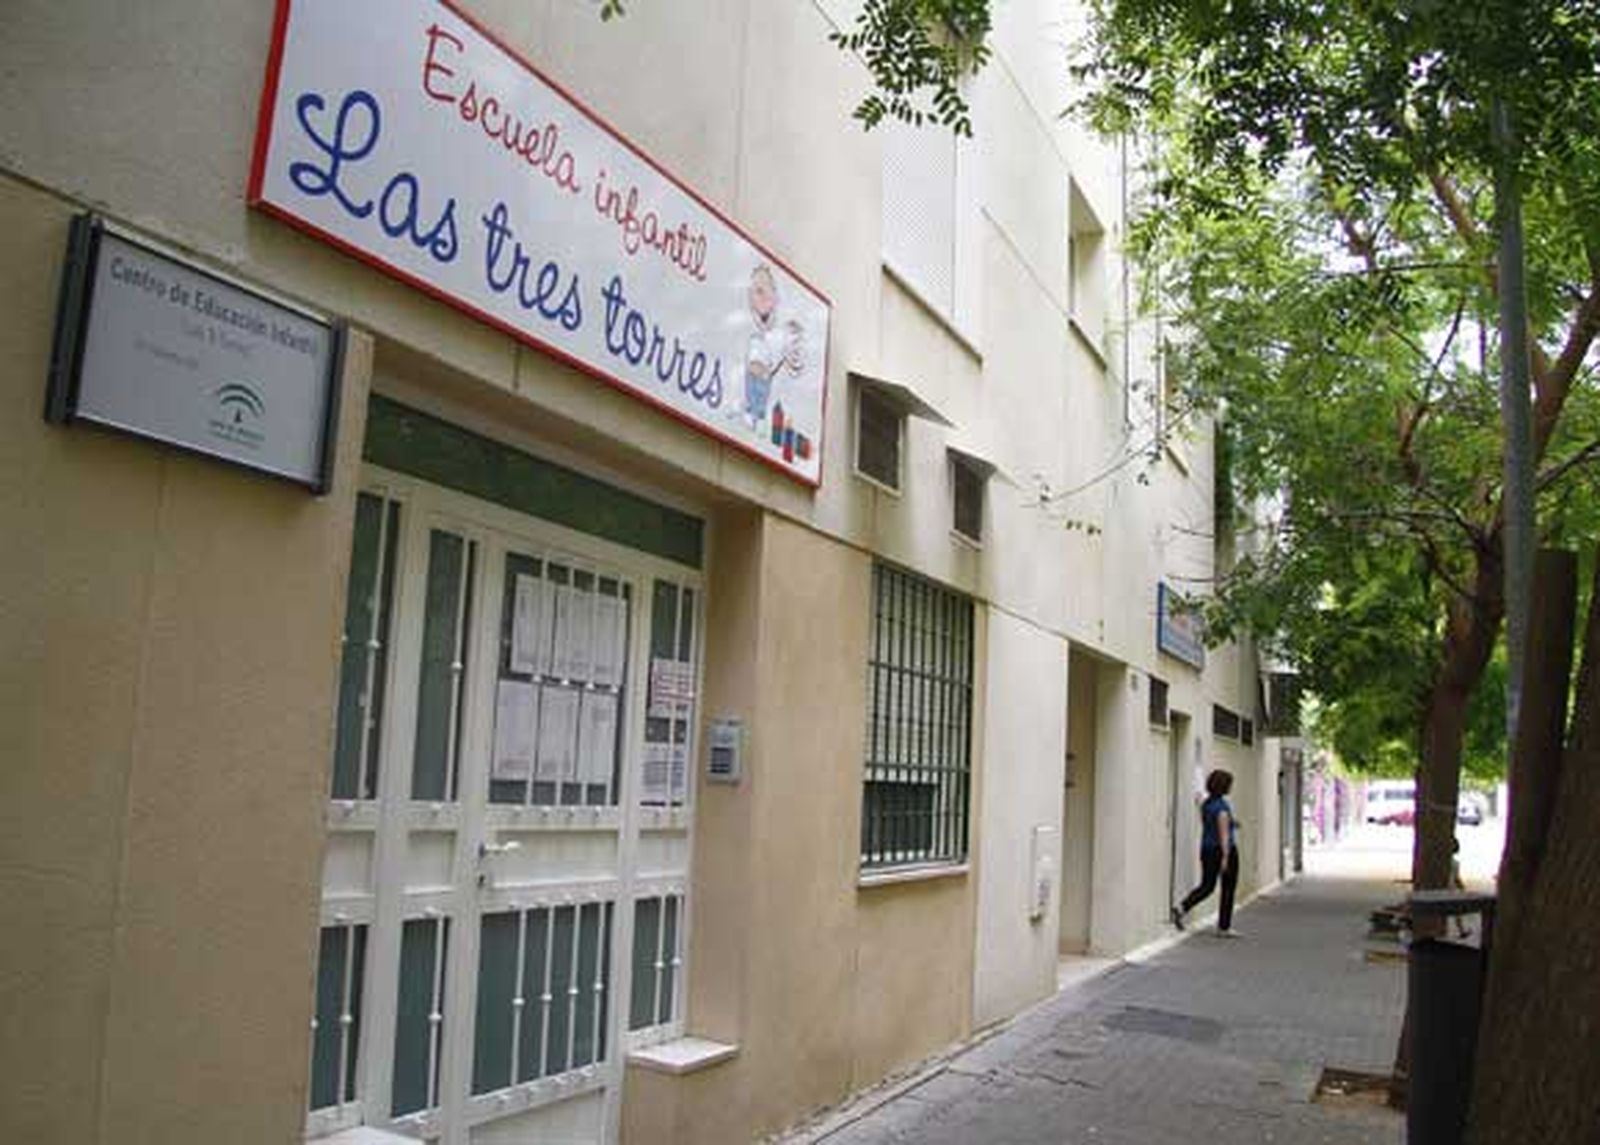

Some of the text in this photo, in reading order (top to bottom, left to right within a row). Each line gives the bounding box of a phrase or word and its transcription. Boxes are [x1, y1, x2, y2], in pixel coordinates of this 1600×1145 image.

[110, 257, 166, 297] Centro
[170, 284, 191, 307] de
[289, 90, 723, 409] Las tres torres
[423, 24, 708, 282] Escuela infantil
